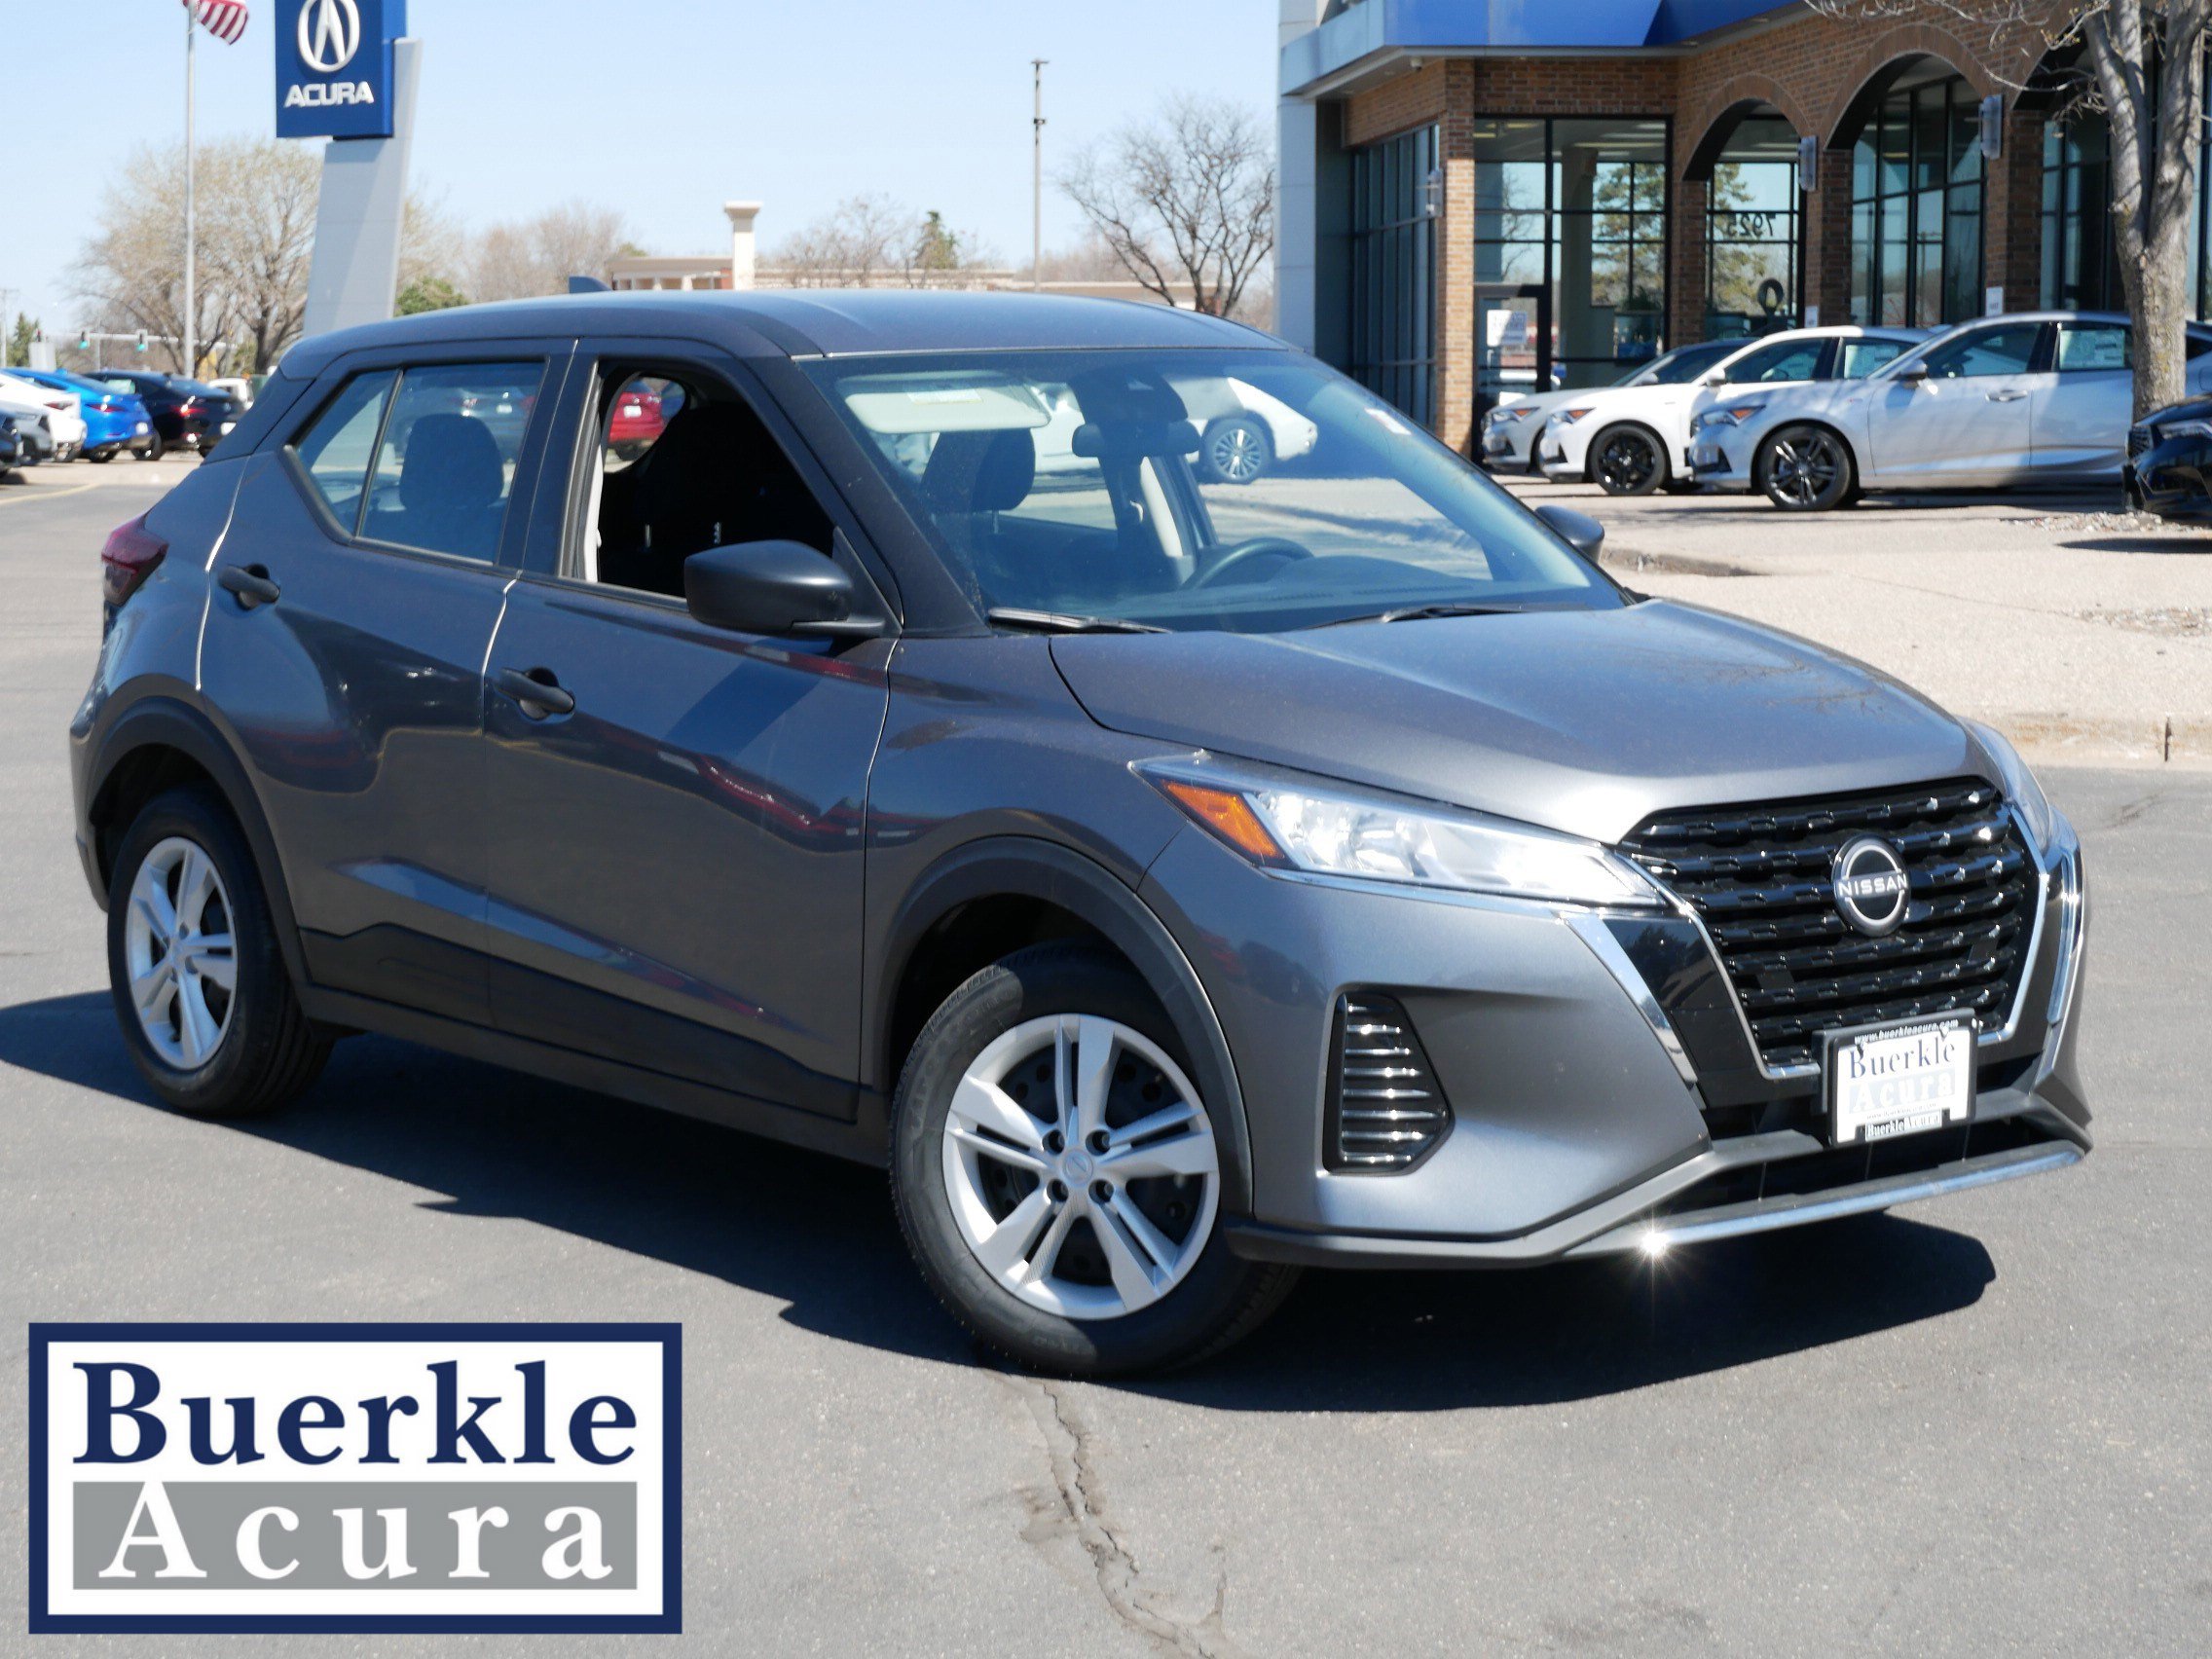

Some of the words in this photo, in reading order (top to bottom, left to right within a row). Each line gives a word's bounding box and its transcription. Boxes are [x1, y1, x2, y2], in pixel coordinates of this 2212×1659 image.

[283, 81, 374, 108] ACURA
[1838, 873, 1907, 897] NISSAN
[1850, 1036, 1955, 1079] Buerkle
[1852, 1072, 1953, 1112] Acura
